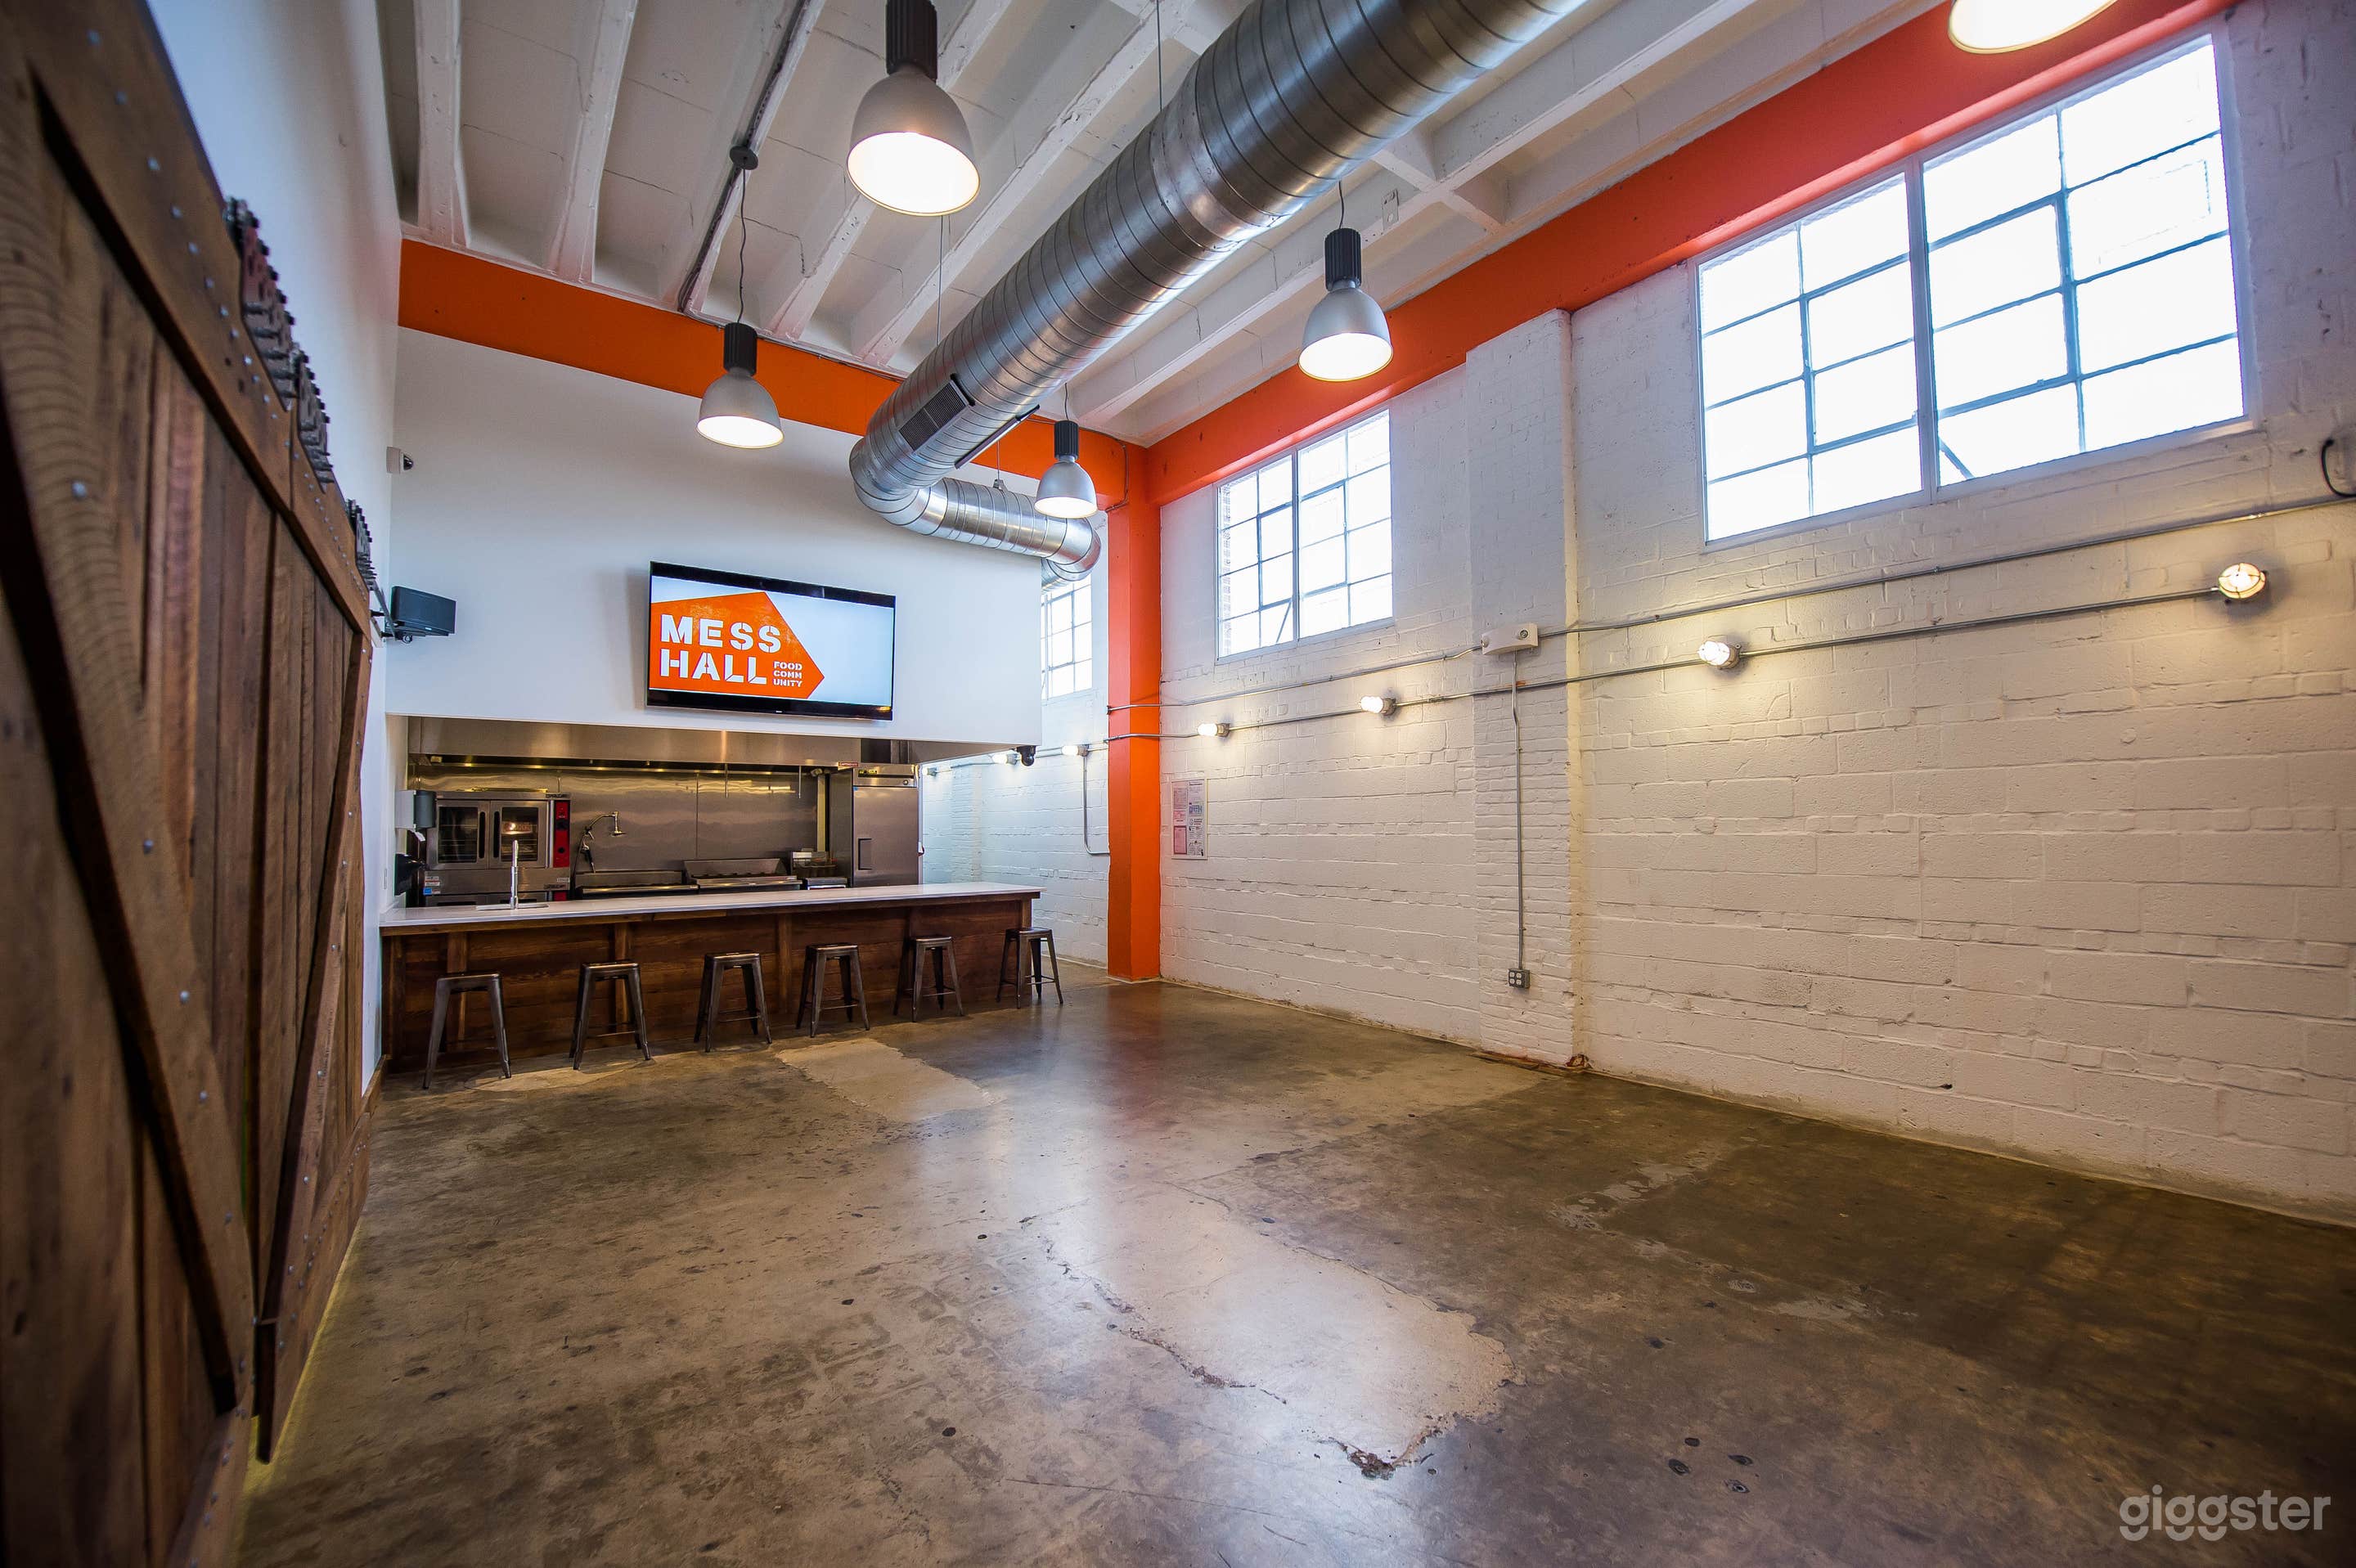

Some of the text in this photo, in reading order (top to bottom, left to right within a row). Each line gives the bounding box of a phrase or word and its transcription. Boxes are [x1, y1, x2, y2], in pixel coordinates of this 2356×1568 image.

[660, 613, 781, 654] MESS
[660, 649, 767, 685] HALL
[773, 661, 803, 671] FOOD
[773, 670, 803, 679] COMM
[773, 678, 803, 687] UNITY
